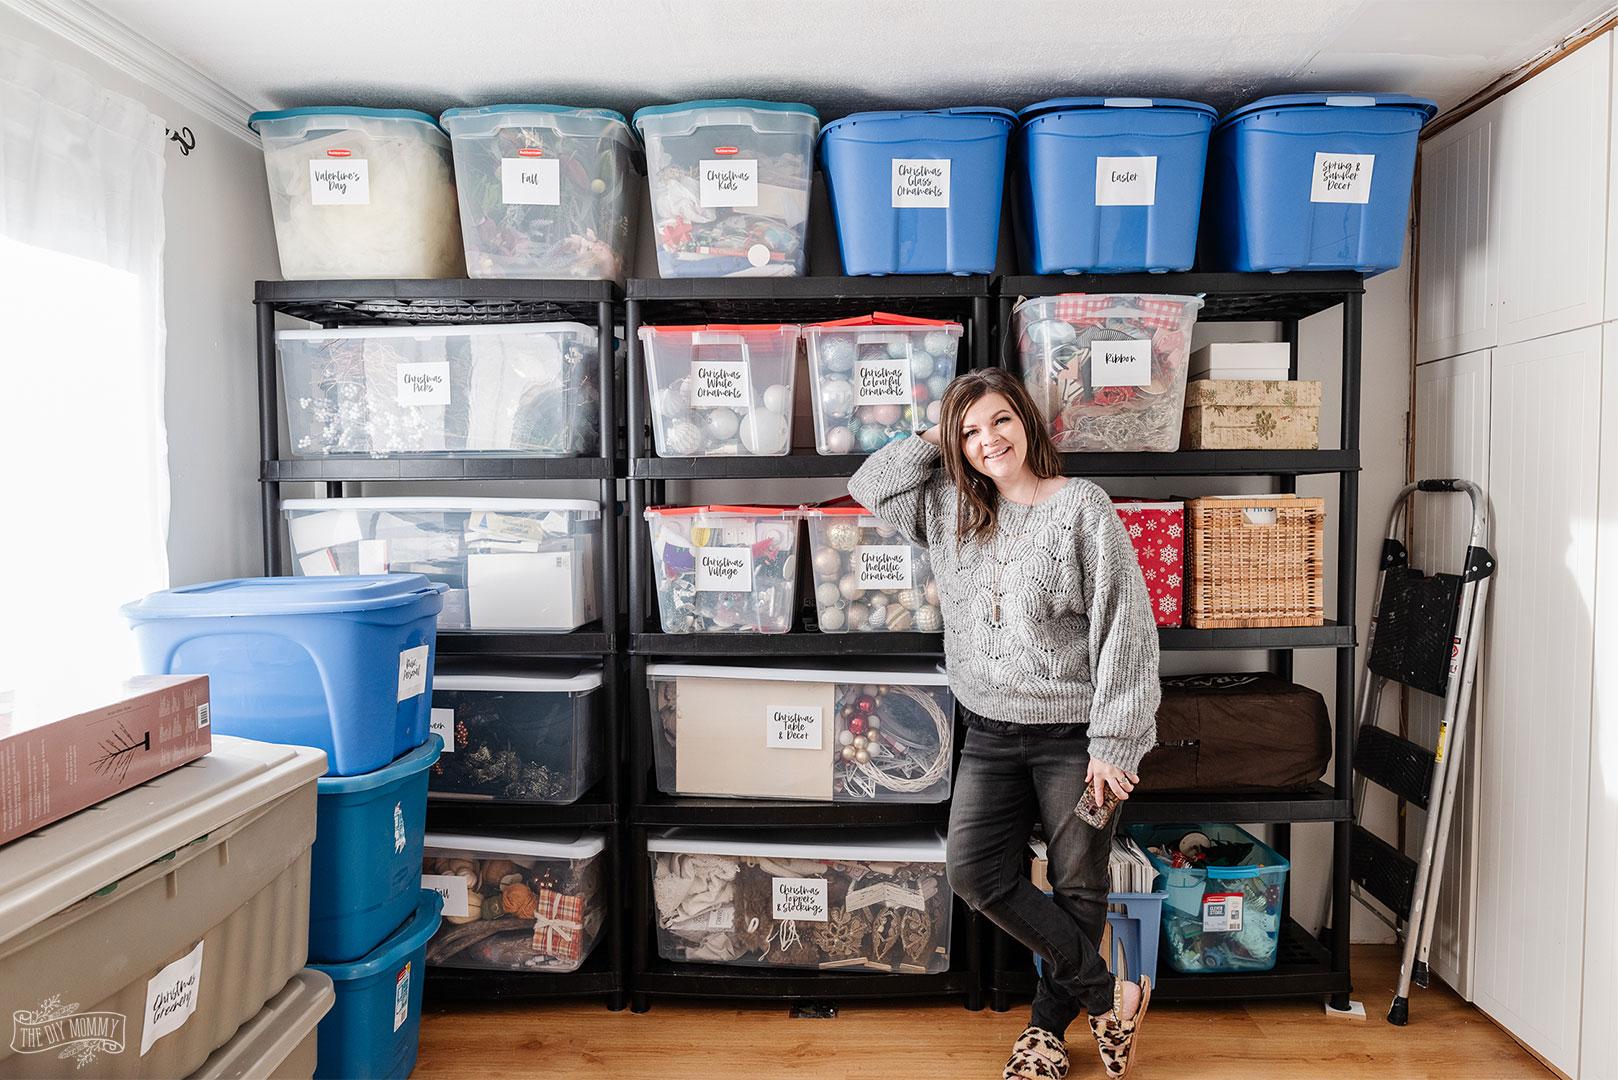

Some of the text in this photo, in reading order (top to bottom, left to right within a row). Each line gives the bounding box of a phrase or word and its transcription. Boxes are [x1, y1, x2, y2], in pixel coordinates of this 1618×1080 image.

[898, 164, 942, 176] Christmas
[1322, 160, 1361, 173] Spring &
[314, 170, 360, 182] Valentine's
[521, 172, 539, 185] Fall
[707, 170, 750, 182] Christmas
[908, 175, 932, 186] Glass
[1111, 171, 1138, 183] Easter
[1323, 171, 1358, 182] Summer
[328, 180, 347, 194] Day
[718, 180, 738, 191] Kids
[896, 186, 943, 197] Ornaments
[1327, 180, 1351, 191] Decor
[1105, 352, 1137, 364] Ribbon
[404, 373, 442, 385] Christmas
[698, 368, 741, 380] Christmas
[860, 368, 903, 379] Christmas
[413, 383, 434, 393] Picks
[706, 378, 733, 388] White
[862, 376, 901, 390] Colourful
[697, 387, 742, 399] Ornaments
[860, 386, 904, 398] Ornaments
[702, 556, 744, 568] Christmas
[861, 552, 904, 564] Christmas
[708, 566, 738, 580] Village
[866, 562, 900, 572] Metallic
[860, 570, 904, 582] Ornaments
[774, 711, 814, 723] Christmas
[782, 721, 806, 732] Table
[778, 730, 809, 740] & Decor
[779, 884, 820, 896] Christmas
[784, 894, 815, 905] Toppers
[153, 975, 196, 1011] Christmas
[153, 990, 192, 1025] Greenery
